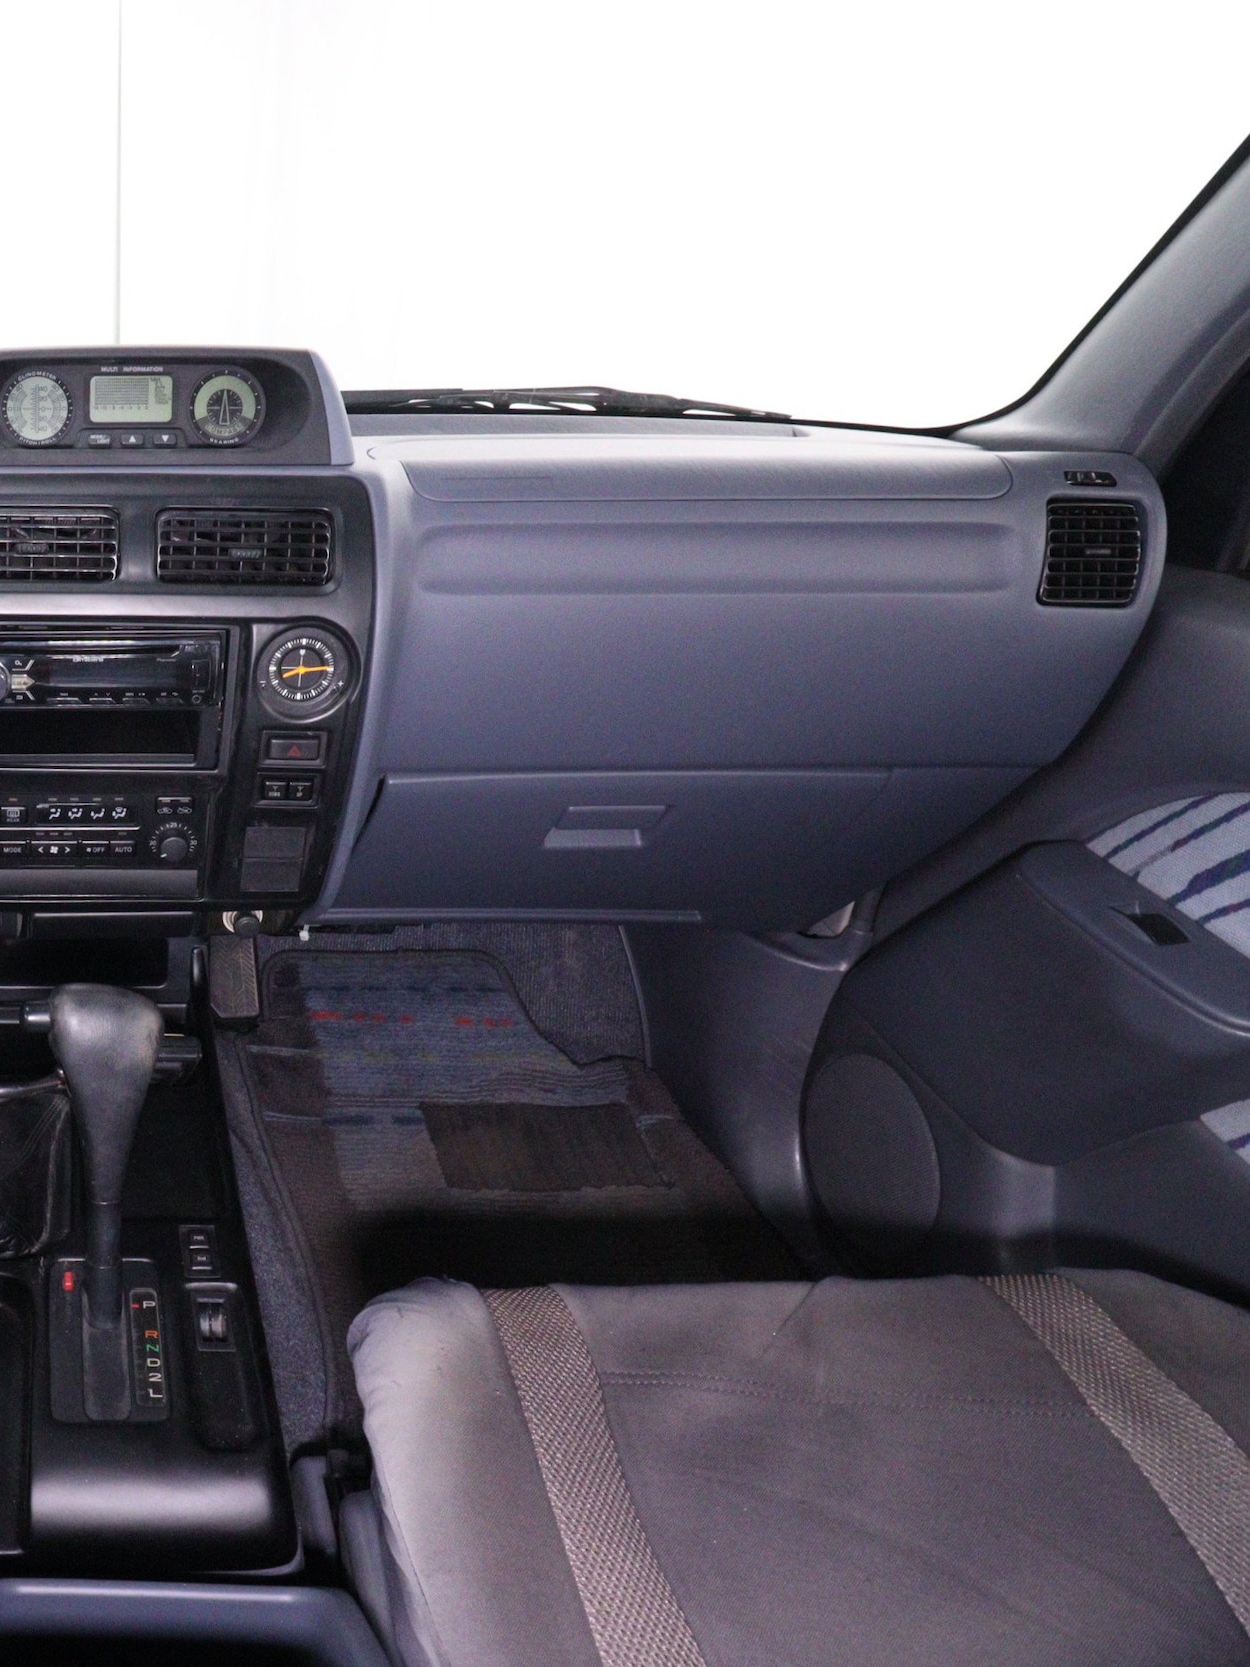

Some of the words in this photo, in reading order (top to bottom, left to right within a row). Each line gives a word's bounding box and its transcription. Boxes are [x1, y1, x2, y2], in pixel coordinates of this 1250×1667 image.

[17, 370, 57, 381] CLINOMETER
[210, 437, 239, 445] BEARING
[142, 1300, 156, 1309] P
[145, 1330, 159, 1339] R
[146, 1344, 160, 1352] N
[146, 1357, 161, 1368] D
[148, 1372, 162, 1382] 2
[148, 1388, 164, 1398] L
